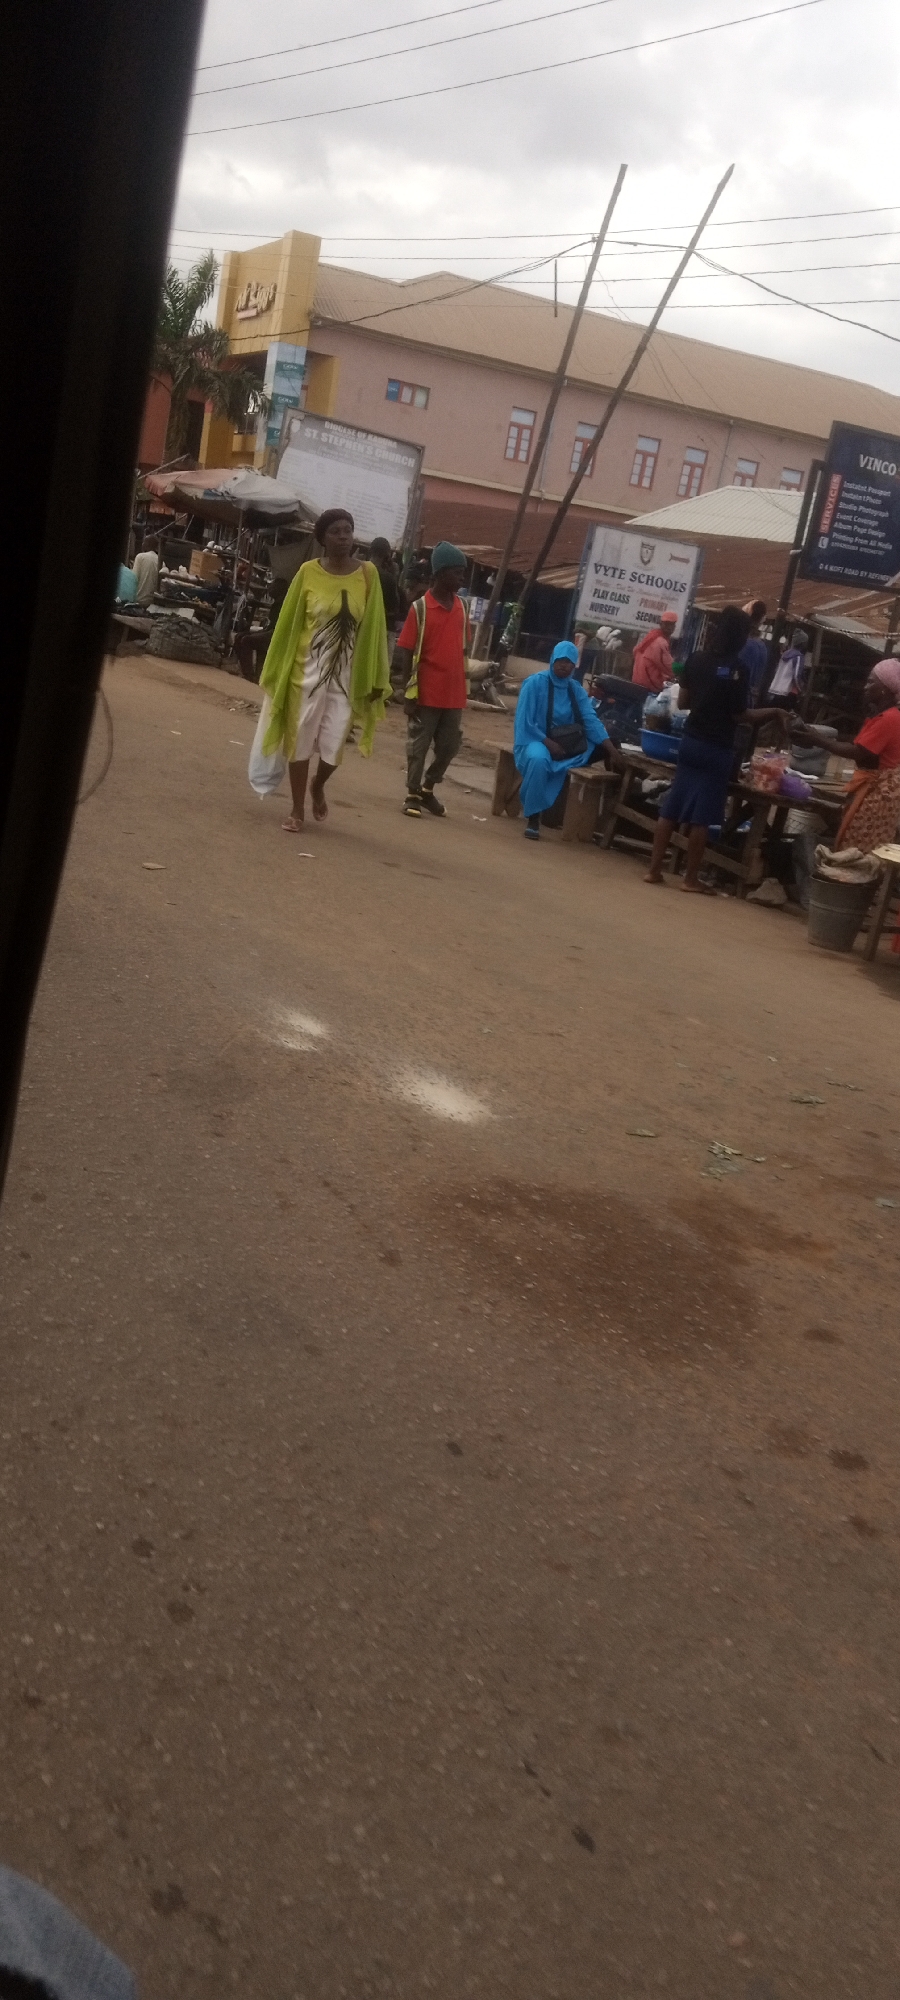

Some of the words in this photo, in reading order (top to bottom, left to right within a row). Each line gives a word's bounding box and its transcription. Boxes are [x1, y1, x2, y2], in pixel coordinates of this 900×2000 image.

[320, 432, 373, 455] STEPHEN'S
[374, 447, 416, 468] CHURCH
[859, 453, 897, 476] VINCO
[593, 562, 627, 581] VYTE
[629, 571, 688, 593] SCHOOLS
[592, 588, 609, 600] PLAY
[609, 591, 631, 605] CLASS
[589, 601, 620, 616] NURSERY
